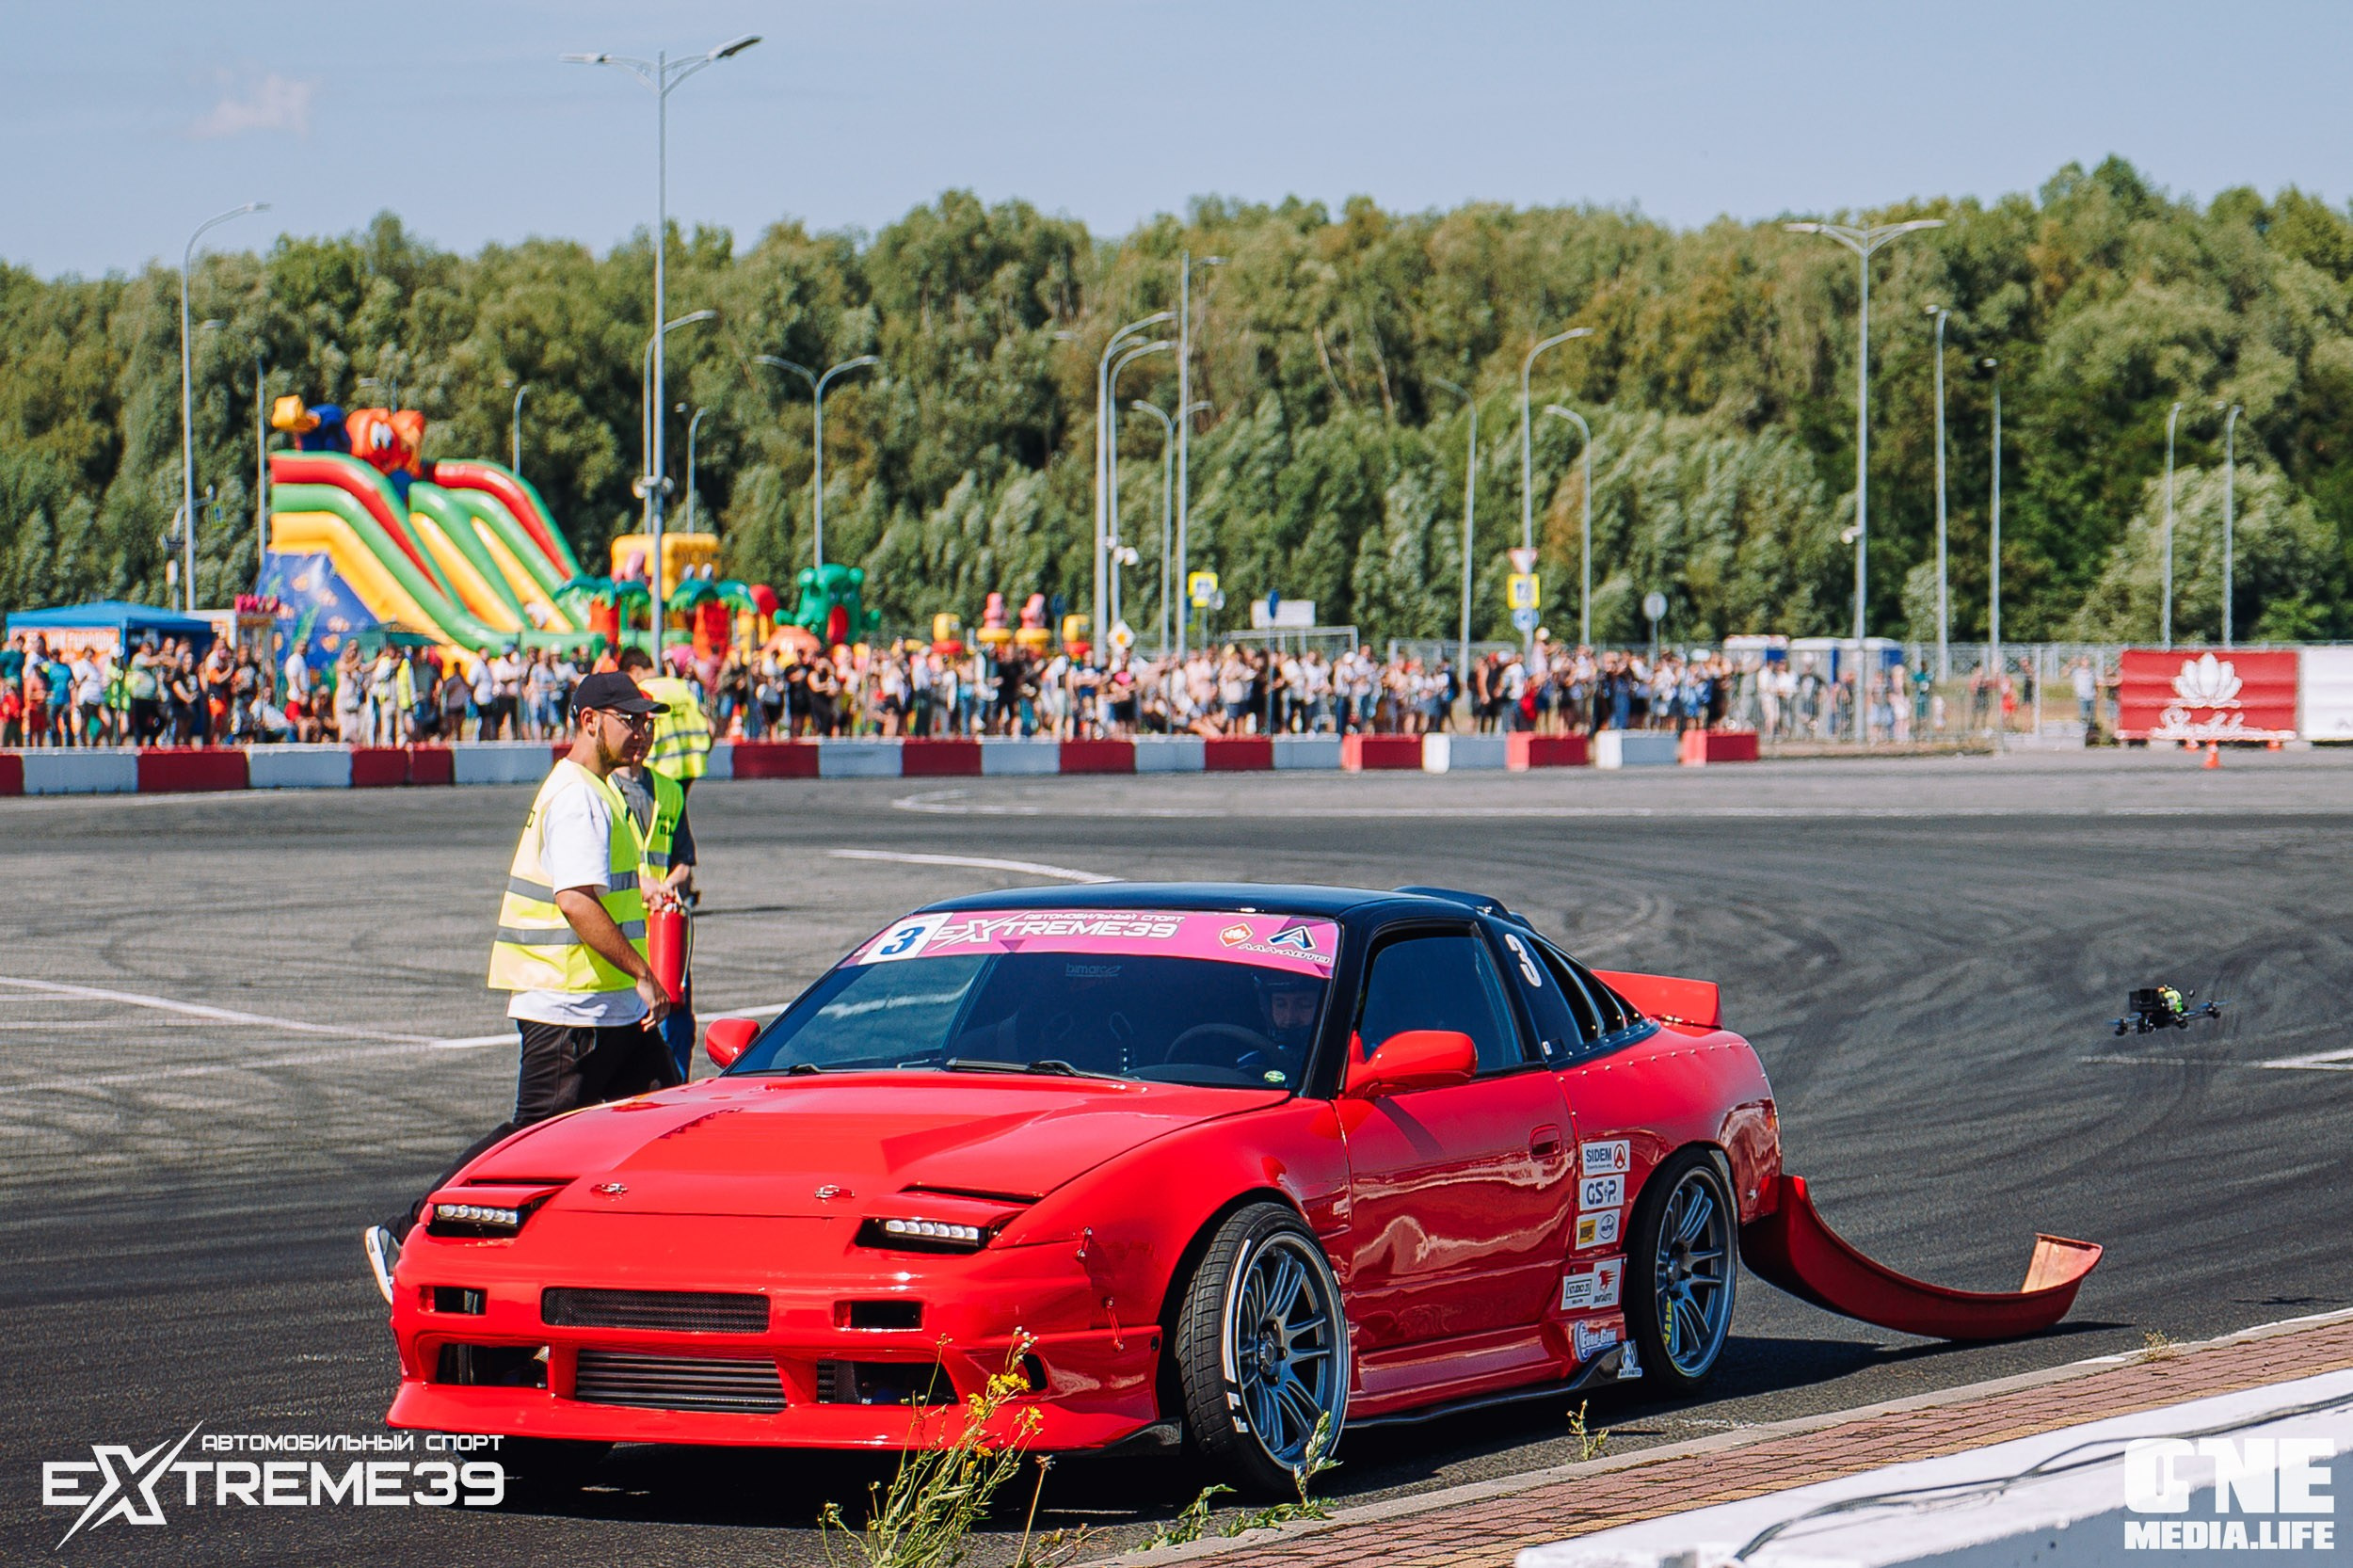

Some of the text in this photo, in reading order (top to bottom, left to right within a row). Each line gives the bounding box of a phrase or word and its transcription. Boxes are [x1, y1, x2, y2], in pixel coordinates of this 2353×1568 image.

[1024, 913, 1185, 922] АВТОМОБИЛЬНЫЙ СПОРТ
[880, 926, 925, 955] 3
[1505, 933, 1542, 987] 3
[1586, 1147, 1612, 1162] SIDEM
